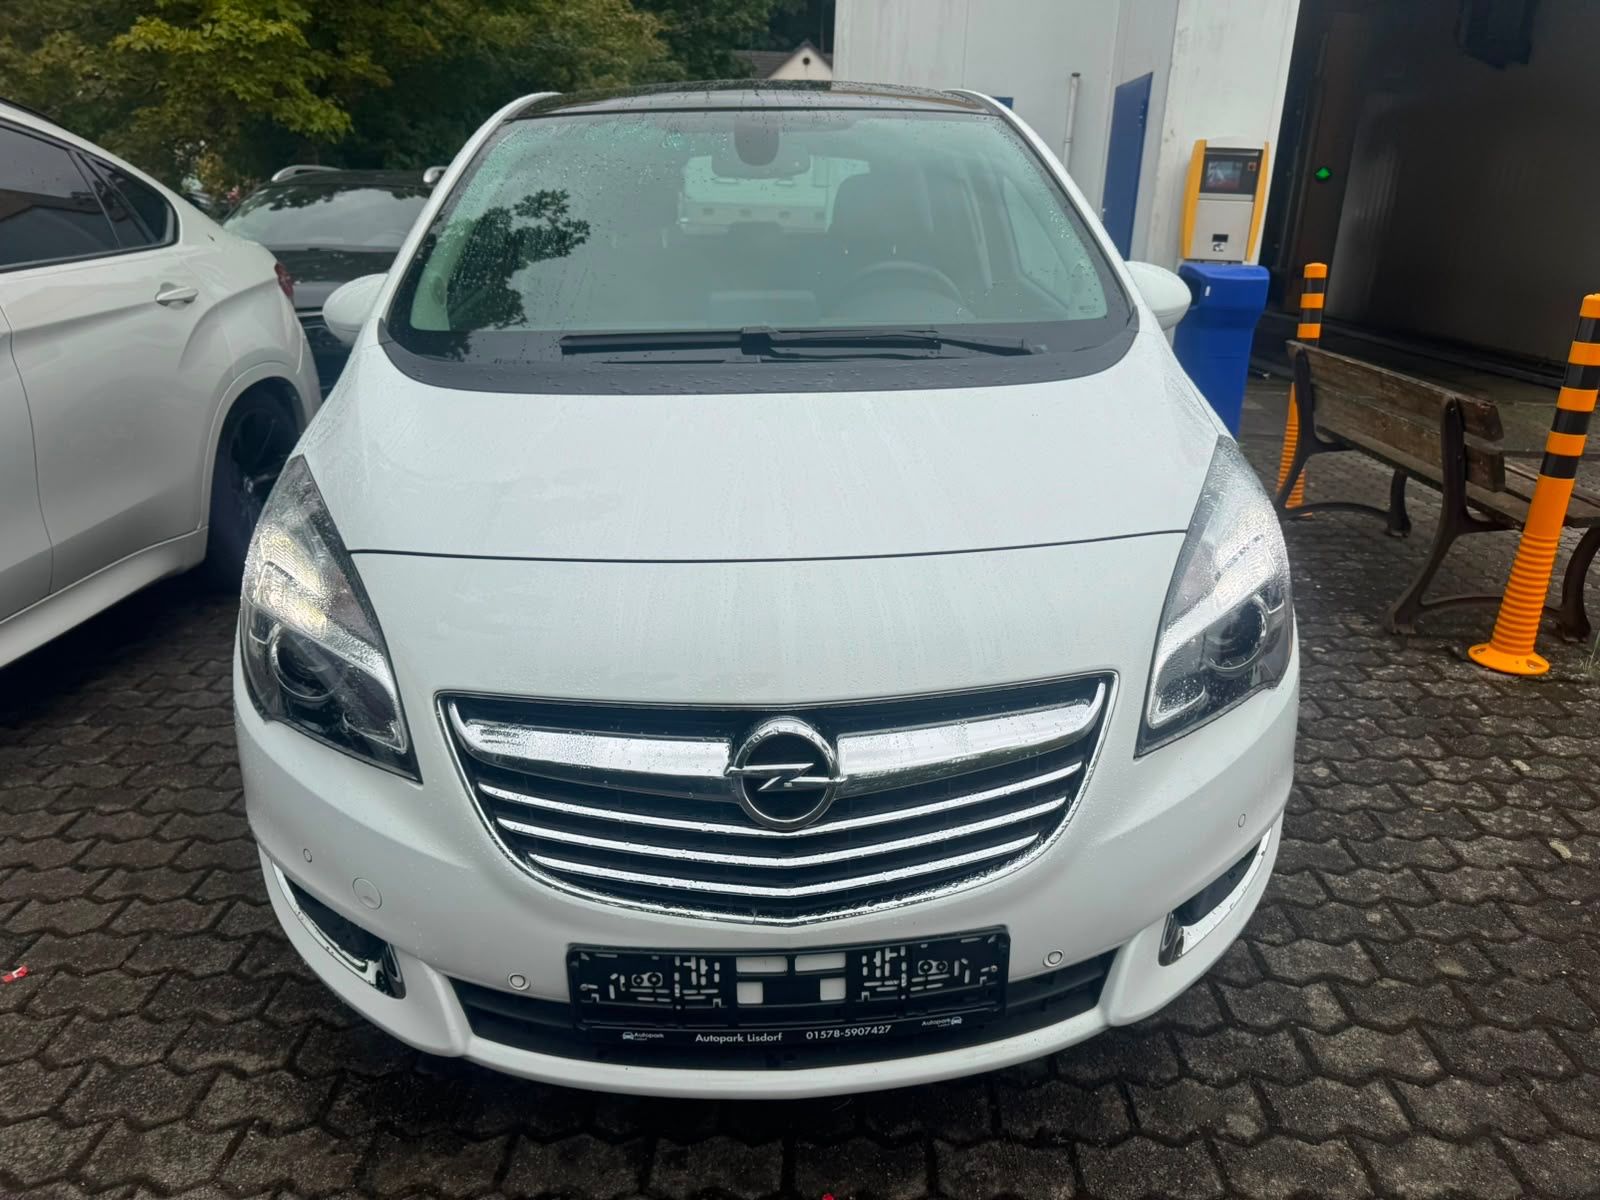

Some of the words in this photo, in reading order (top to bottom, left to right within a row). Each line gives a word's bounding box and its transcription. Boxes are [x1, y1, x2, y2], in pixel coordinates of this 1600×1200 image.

[695, 1033, 744, 1044] Autopark
[747, 1032, 783, 1042] Lisdorf
[806, 1024, 892, 1040] 01578-5907427
